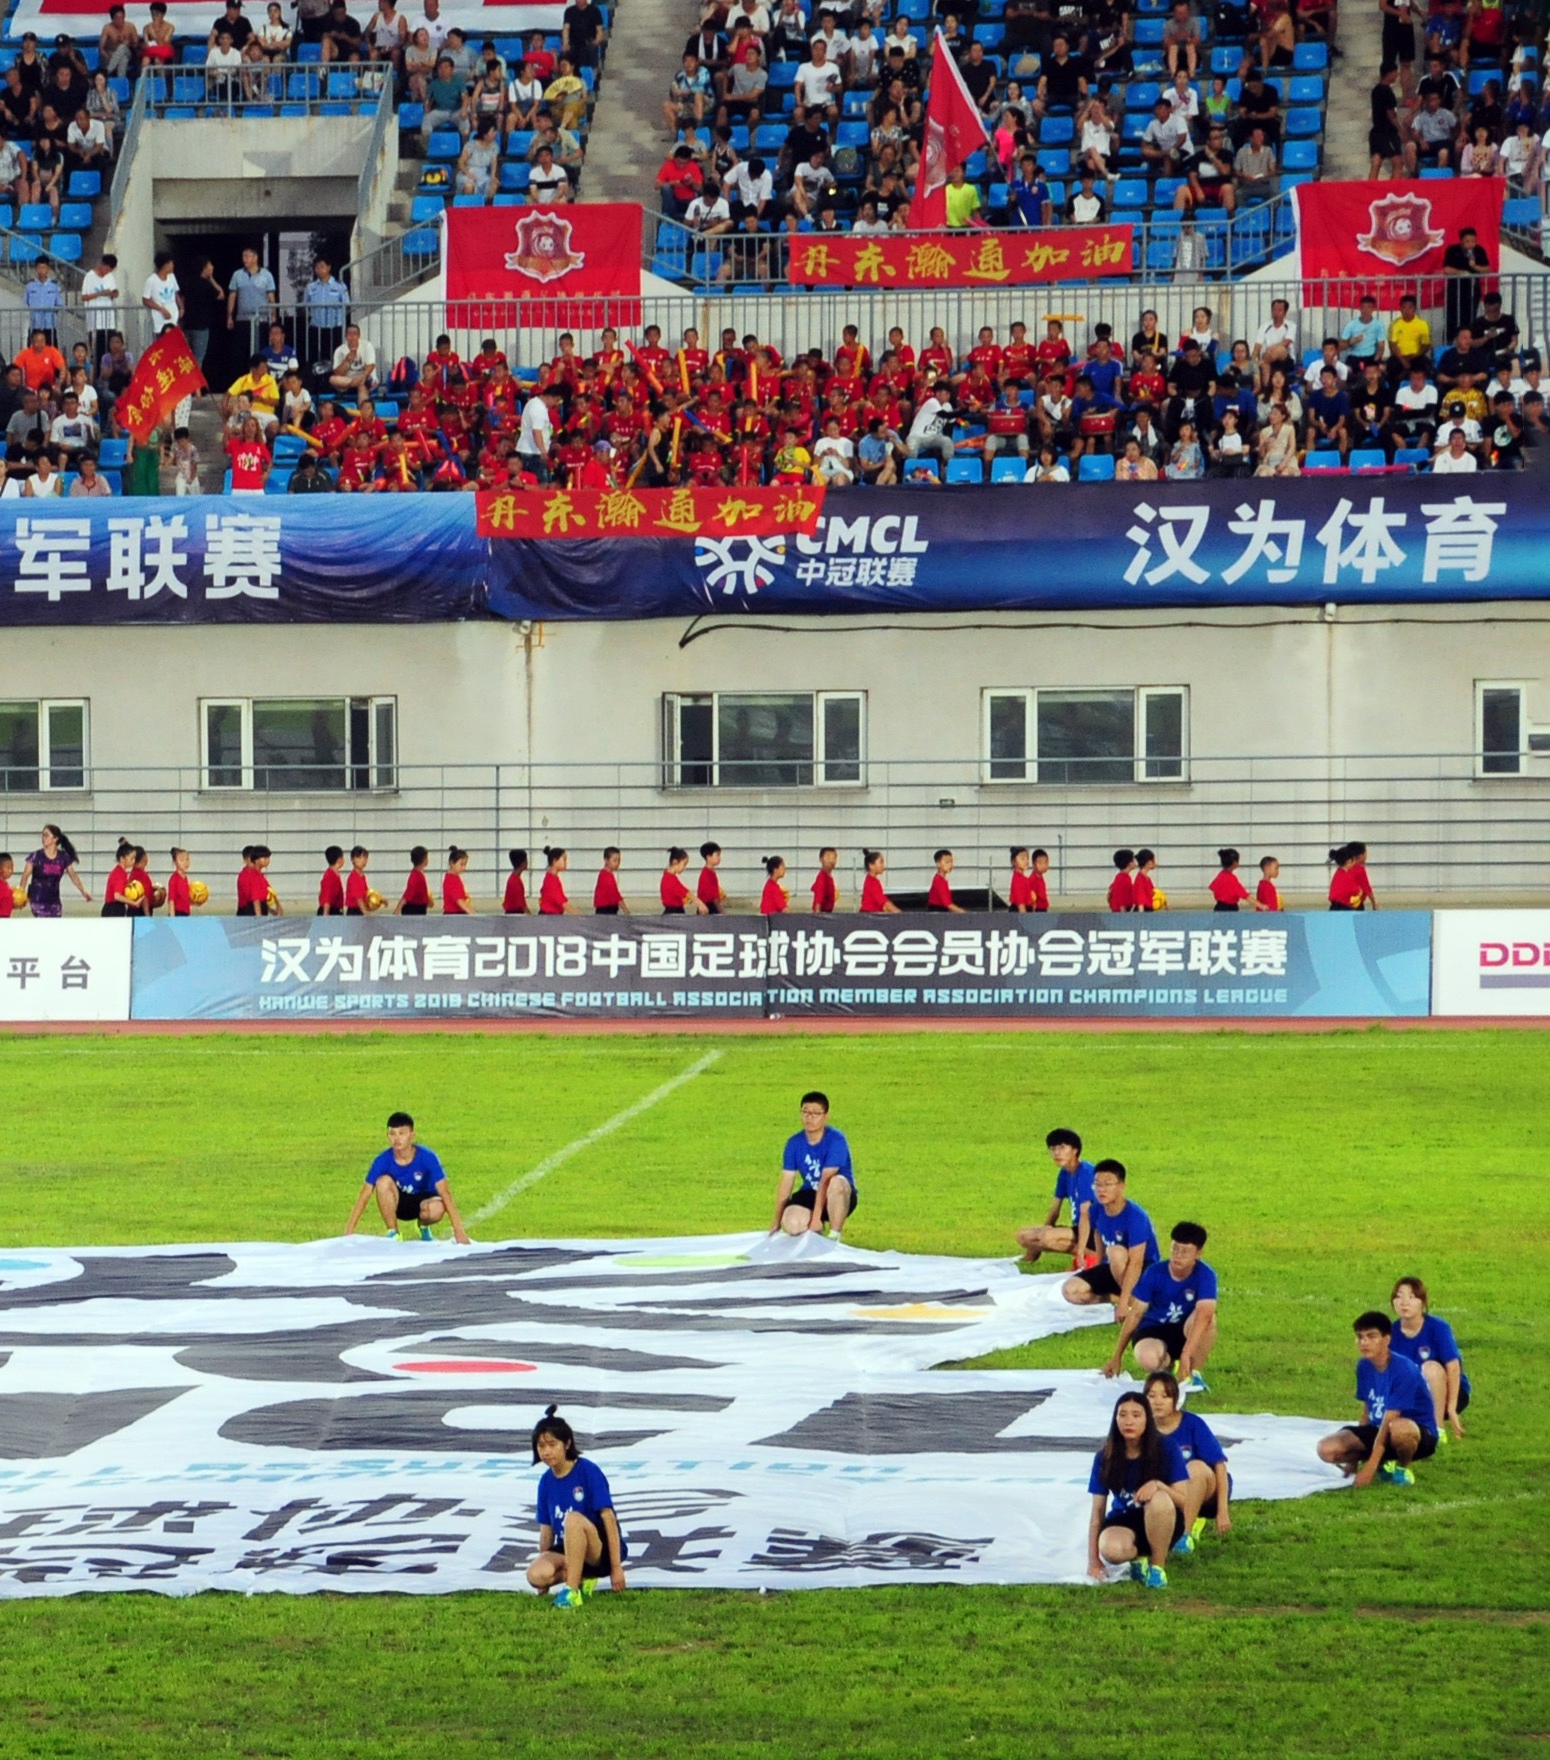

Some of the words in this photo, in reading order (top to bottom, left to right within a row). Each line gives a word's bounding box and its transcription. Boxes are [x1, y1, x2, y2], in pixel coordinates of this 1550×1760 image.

[794, 233, 1126, 281] 丹东瀚通加油
[481, 488, 817, 533] 丹东瀚通加油
[796, 514, 929, 555] CMCL
[1123, 495, 1508, 586] 汉为体育
[796, 556, 918, 587] 中冠联赛
[259, 994, 328, 1010] HANWE
[334, 993, 409, 1009] SPORTS
[467, 991, 556, 1008] CHINESE
[561, 991, 667, 1008] FOOTBALL
[819, 988, 917, 1004] MEMBER
[922, 988, 1064, 1004] ASSOCIATION
[1069, 988, 1198, 1004] CHAMPIONS
[1203, 987, 1289, 1004] LEAGUE
